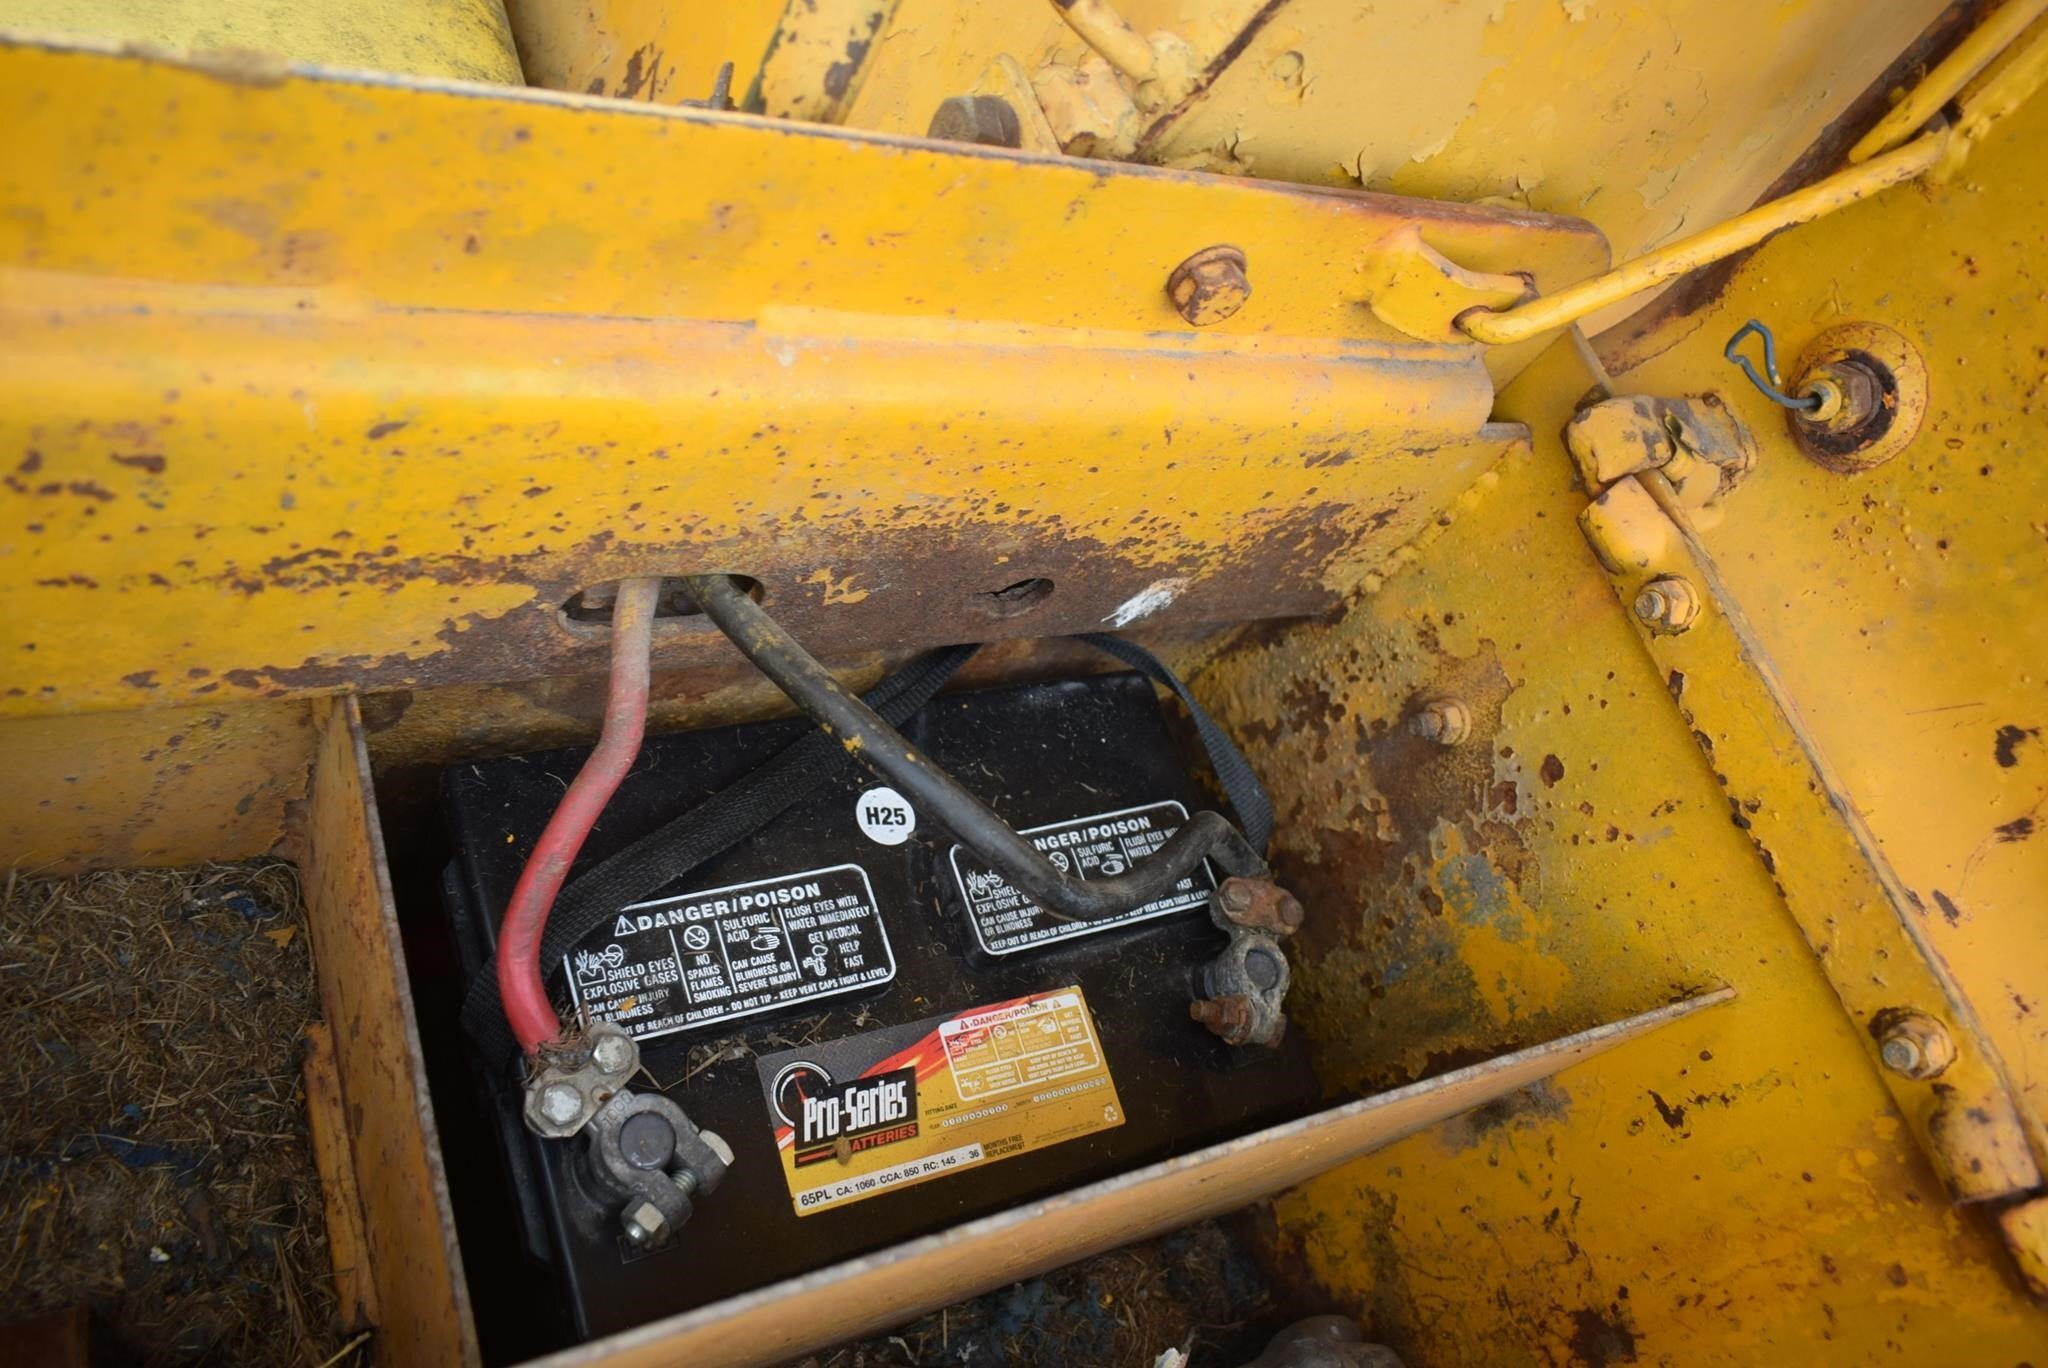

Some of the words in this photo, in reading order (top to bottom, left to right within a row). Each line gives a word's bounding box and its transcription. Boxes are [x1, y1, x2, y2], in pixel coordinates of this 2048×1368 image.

[866, 806, 906, 826] H25
[1033, 816, 1152, 851] NGER/POISON
[1124, 834, 1146, 848] FLUSH
[1146, 830, 1164, 842] EYES
[1077, 841, 1115, 858] SULFURIC
[1128, 845, 1152, 858] WATER
[1082, 855, 1099, 868] ACID
[992, 886, 1021, 899] SHIEL
[637, 883, 821, 930] DANGER/POISON
[784, 904, 812, 919] FLUSH
[813, 900, 835, 913] EYES
[836, 895, 859, 907] WITH
[975, 895, 1020, 914] EXPLOSIVE
[1143, 902, 1160, 913] VENT
[1159, 897, 1175, 909] CAPS
[1173, 893, 1191, 905] TIGHT
[722, 913, 770, 932] SULFURIC
[788, 917, 817, 932] WATER
[818, 906, 871, 925] IMMEDIATELY
[980, 915, 996, 927] CAN
[995, 909, 1019, 924] CAUSE
[984, 926, 996, 937] OR
[995, 918, 1033, 935] BLINDNESS
[727, 929, 750, 944] ACID
[808, 932, 824, 944] GET
[826, 924, 863, 940] MEDICAL
[990, 938, 1009, 950] KEEP
[1008, 935, 1020, 946] OUT
[1020, 933, 1029, 943] OF
[1029, 928, 1051, 941] REACH
[1050, 926, 1059, 937] OF
[1059, 920, 1088, 934] CHILDREN
[839, 941, 861, 954] HELP
[696, 953, 711, 966] NO
[732, 959, 748, 971] CAN
[751, 952, 777, 967] CAUSE
[843, 955, 865, 968] FAST
[607, 963, 645, 982] SHIELD
[648, 957, 676, 973] EYES
[687, 964, 720, 981] SPARKS
[735, 964, 778, 983] BLINDNESS
[780, 961, 793, 972] OR
[583, 978, 641, 1000] EXPLOSIVE
[644, 970, 679, 986] GASES
[690, 975, 724, 992] FLAMES
[739, 977, 769, 993] SEVERE
[769, 971, 798, 986] INJURY
[587, 1002, 606, 1015] CAN
[638, 988, 670, 1004] INJURY
[635, 1022, 646, 1033] OF
[648, 1016, 675, 1032] REACH
[674, 1014, 685, 1025] OF
[686, 1004, 725, 1021] CHILDREN
[730, 1000, 743, 1011] DO
[744, 996, 759, 1009] NOT
[760, 993, 773, 1005] TIP
[779, 987, 798, 1001] KEEP
[798, 983, 818, 996] VENT
[819, 978, 839, 991] CAPS
[839, 974, 861, 987] TIGHT
[860, 971, 867, 981] &
[868, 967, 889, 980] LEVEL
[693, 986, 732, 1003] SMOKING
[590, 1014, 603, 1025] OR
[604, 1003, 654, 1023] BLINDNESS
[803, 1080, 908, 1142] Pro-Series
[851, 1124, 917, 1152] ATTERIES
[983, 1139, 1008, 1150] MONTHS
[1008, 1134, 1023, 1144] FREE
[985, 1142, 1025, 1158] REPLACEMENT
[801, 1190, 832, 1206] 65PL
[836, 1186, 853, 1197] CA:
[855, 1178, 875, 1191] 1060
[880, 1171, 903, 1184] CCA:
[903, 1166, 920, 1178] 850
[922, 1161, 940, 1172] RC:
[941, 1155, 956, 1167] 145
[968, 1149, 980, 1159] 36
